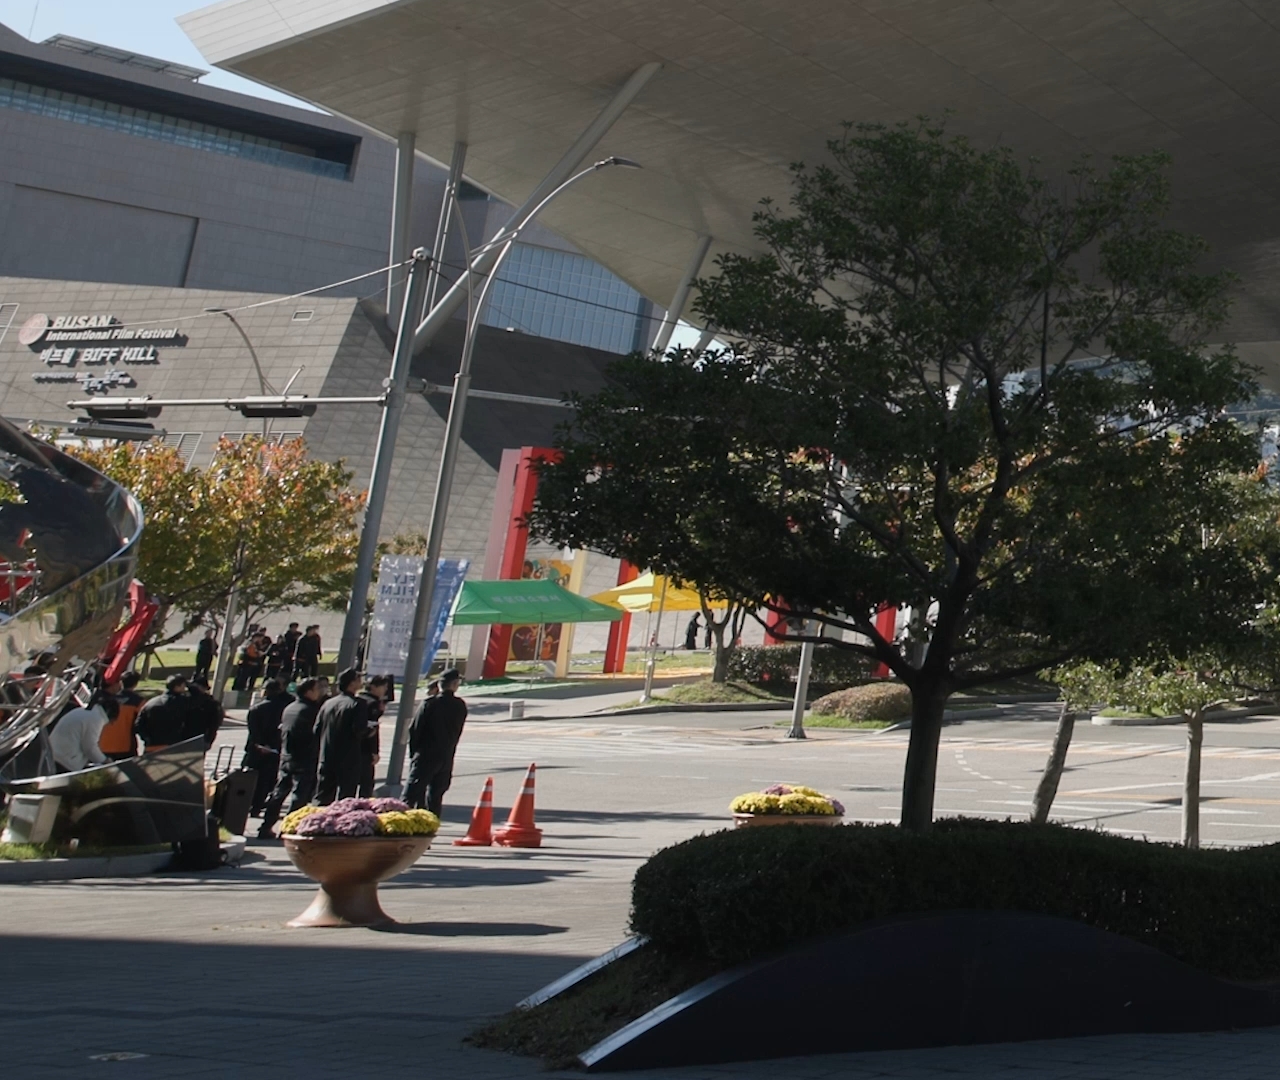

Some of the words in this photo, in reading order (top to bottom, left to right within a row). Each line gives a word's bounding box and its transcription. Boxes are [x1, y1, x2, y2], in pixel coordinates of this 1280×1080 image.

[52, 315, 113, 329] BUSAN
[46, 330, 111, 341] International
[111, 329, 135, 340] Film
[135, 328, 177, 339] Festival
[39, 347, 77, 364] 비프힐
[80, 347, 119, 362] BIFF
[120, 346, 155, 361] HILL
